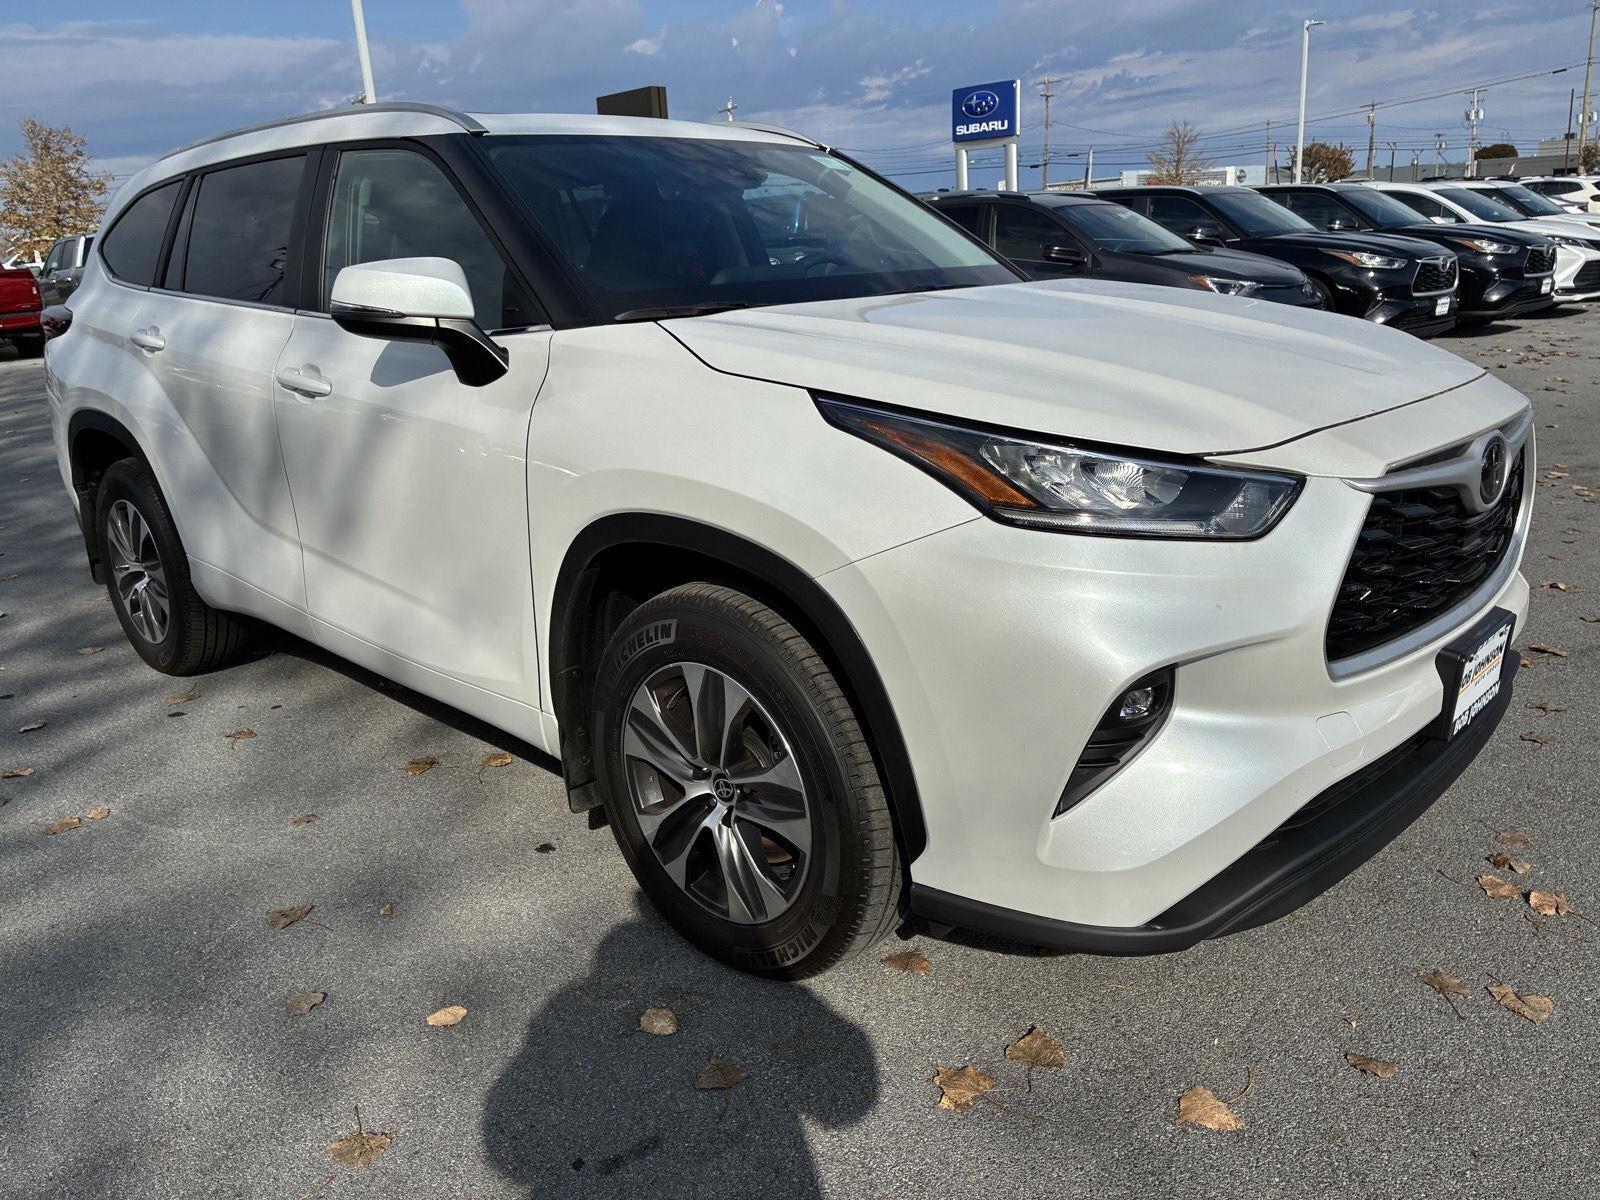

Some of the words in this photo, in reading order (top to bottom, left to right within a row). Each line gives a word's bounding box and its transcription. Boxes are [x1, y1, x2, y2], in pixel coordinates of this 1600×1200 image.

[956, 119, 1008, 135] SUBARU
[1453, 708, 1470, 736] BOB
[1467, 679, 1501, 726] JOHNSON
